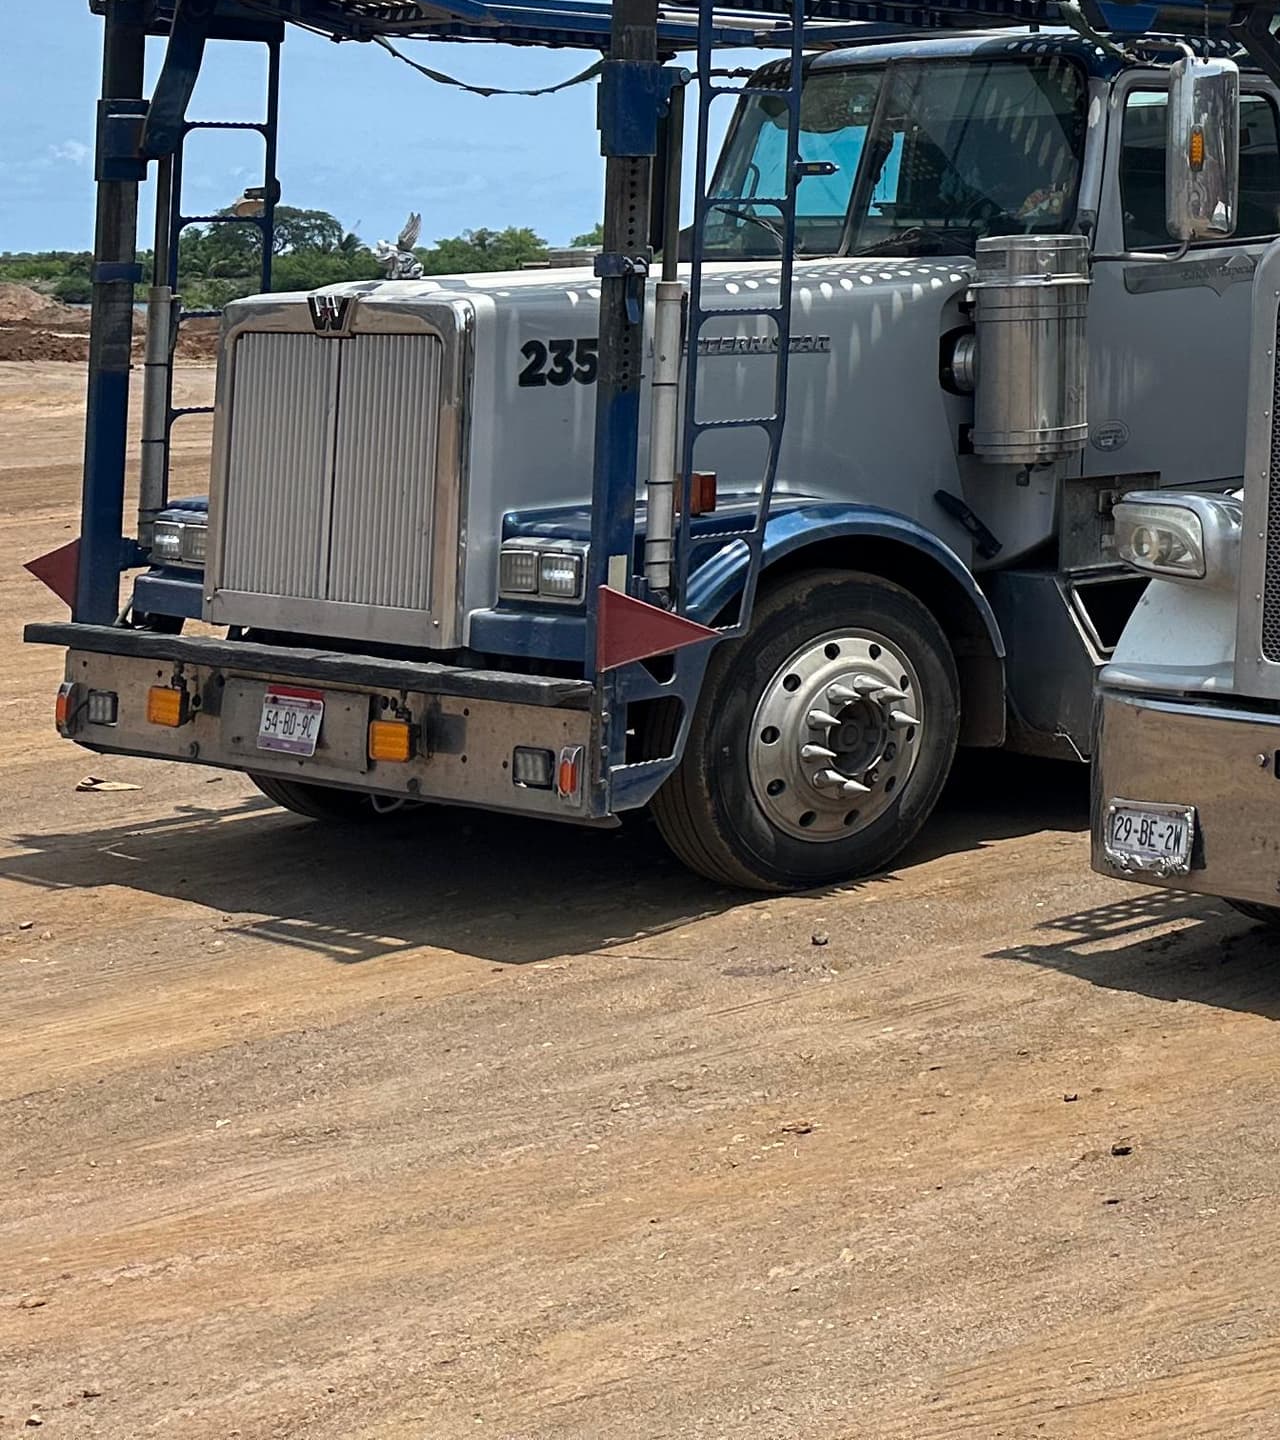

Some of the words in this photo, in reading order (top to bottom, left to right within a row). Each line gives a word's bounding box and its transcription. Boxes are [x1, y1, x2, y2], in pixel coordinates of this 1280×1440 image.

[518, 338, 600, 388] 235
[264, 710, 316, 738] 54-BD-9C
[1114, 815, 1183, 855] 29-BE-2W
